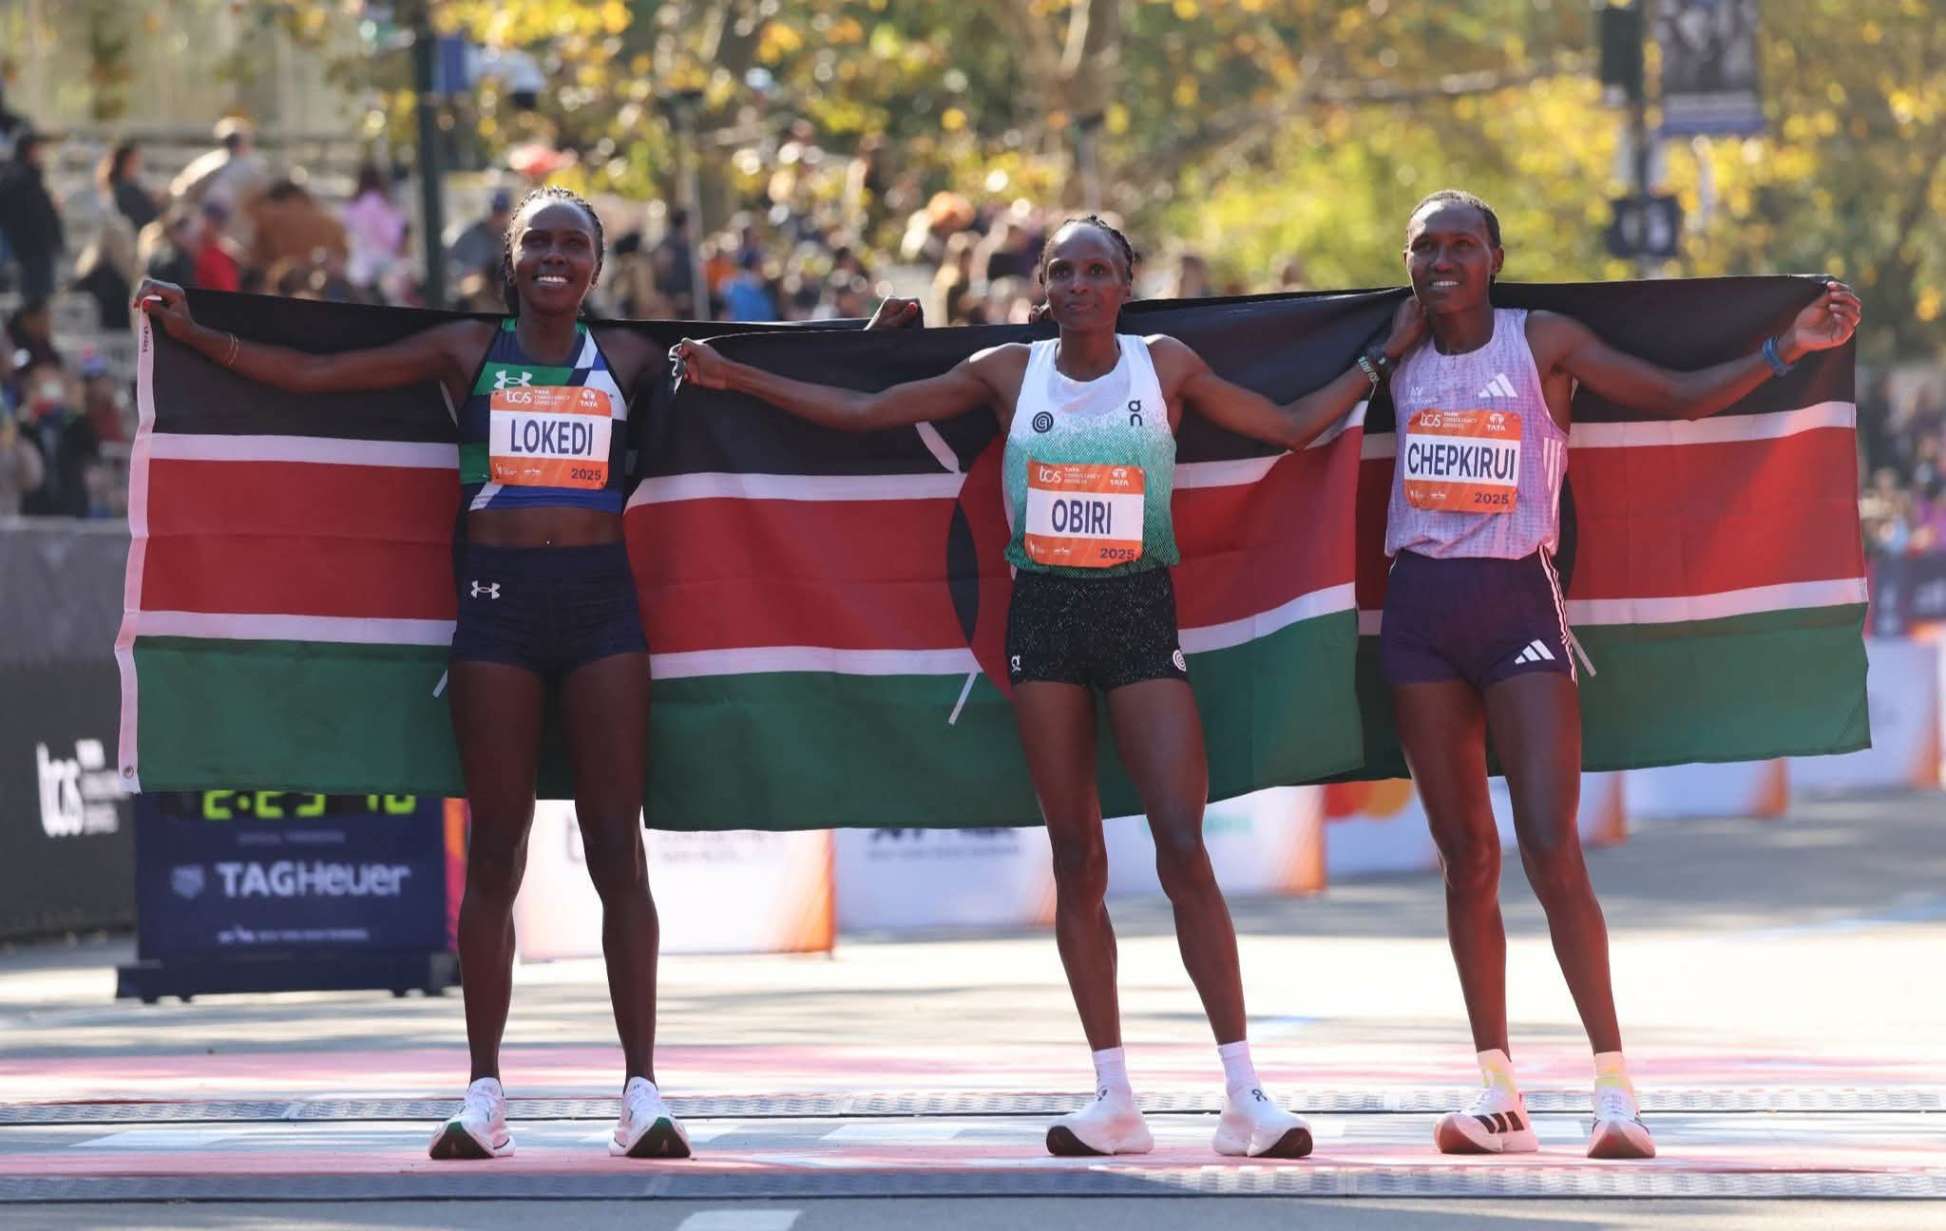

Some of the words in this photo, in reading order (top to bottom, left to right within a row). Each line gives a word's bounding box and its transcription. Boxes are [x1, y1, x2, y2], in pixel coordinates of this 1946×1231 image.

[510, 419, 593, 456] LOKEDI
[1407, 442, 1516, 480] CHEPKIRUI
[570, 468, 601, 481] 2025
[1474, 492, 1509, 505] 2025
[1051, 499, 1112, 535] OBIRI
[1100, 548, 1135, 560] 2025
